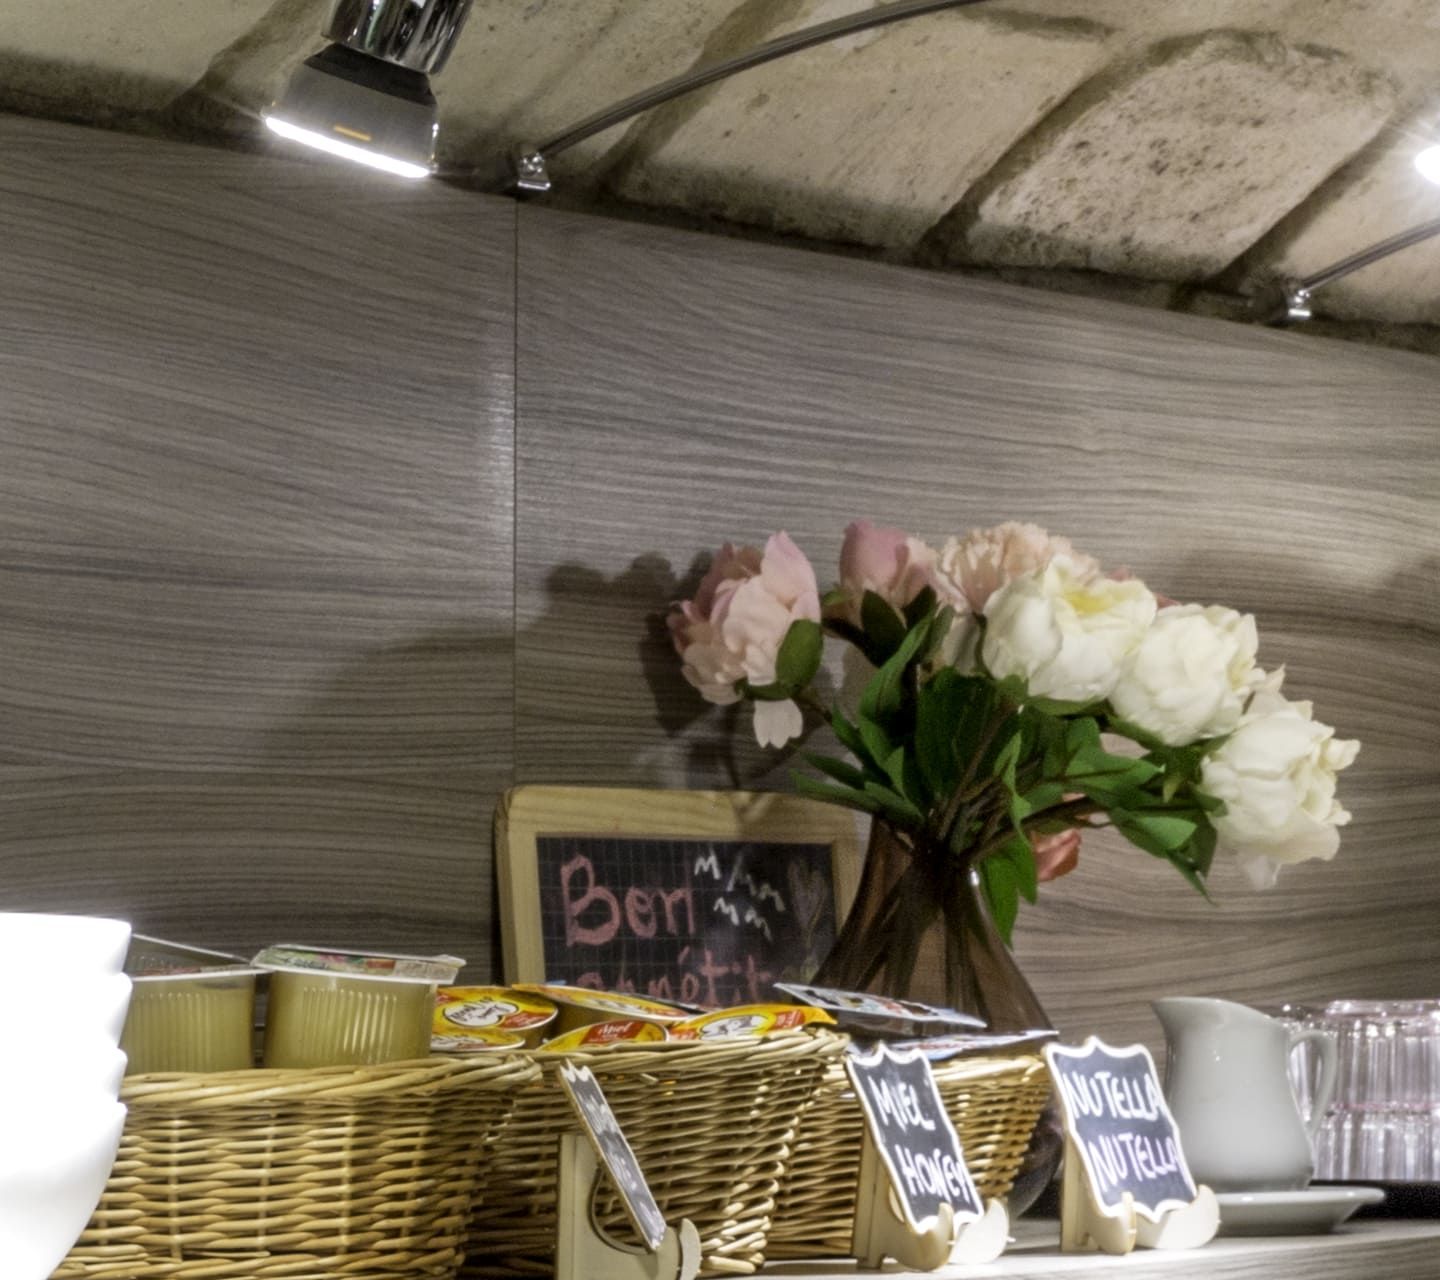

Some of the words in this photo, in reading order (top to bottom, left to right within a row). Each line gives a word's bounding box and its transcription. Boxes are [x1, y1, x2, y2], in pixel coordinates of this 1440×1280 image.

[560, 853, 696, 948] Bon
[576, 946, 776, 1004] étit
[868, 1075, 936, 1134] MIEL
[1062, 1071, 1166, 1122] NUTELLA
[895, 1144, 971, 1205] HONEY
[1087, 1131, 1190, 1193] NUTELLA
